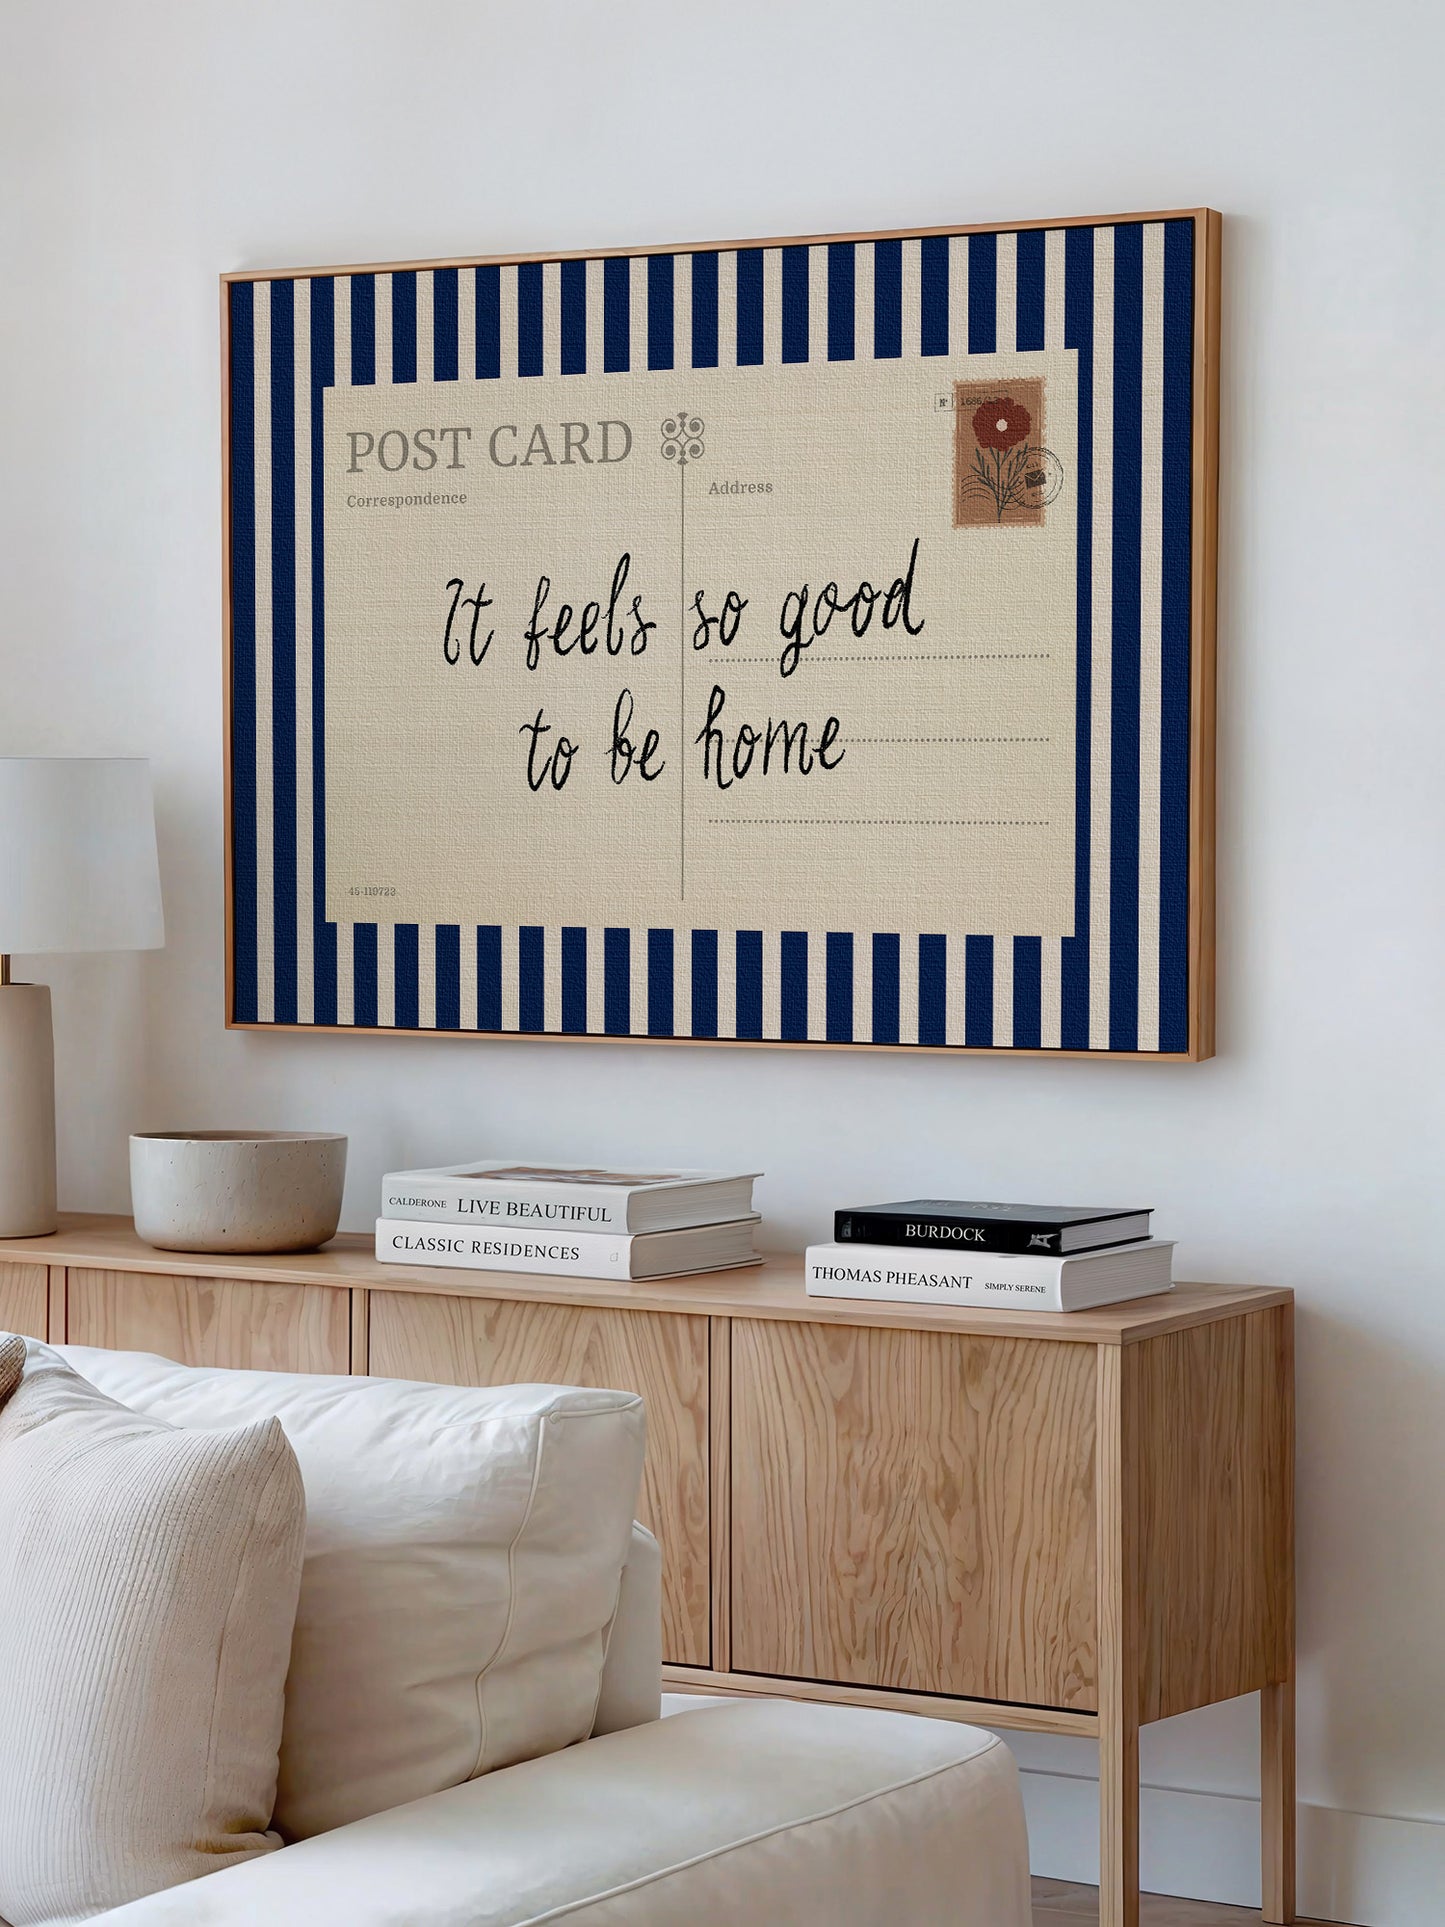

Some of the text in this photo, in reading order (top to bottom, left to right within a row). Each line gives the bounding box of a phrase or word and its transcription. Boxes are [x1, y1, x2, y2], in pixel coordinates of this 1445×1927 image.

[346, 420, 633, 473] POST CARD
[708, 480, 774, 495] Address
[346, 491, 468, 509] Correspondence
[443, 537, 926, 678] It feels so good
[518, 684, 846, 792] to be home
[388, 1196, 448, 1209] CALDERONE
[456, 1198, 613, 1223] LIVE BEAUTIFUL
[905, 1223, 987, 1243] BURDOCK
[391, 1235, 580, 1262] CLASSIC RESIDENCES
[812, 1266, 973, 1290] THOMAS PHEASANT
[984, 1282, 1047, 1294] SIMPLY SERENE
